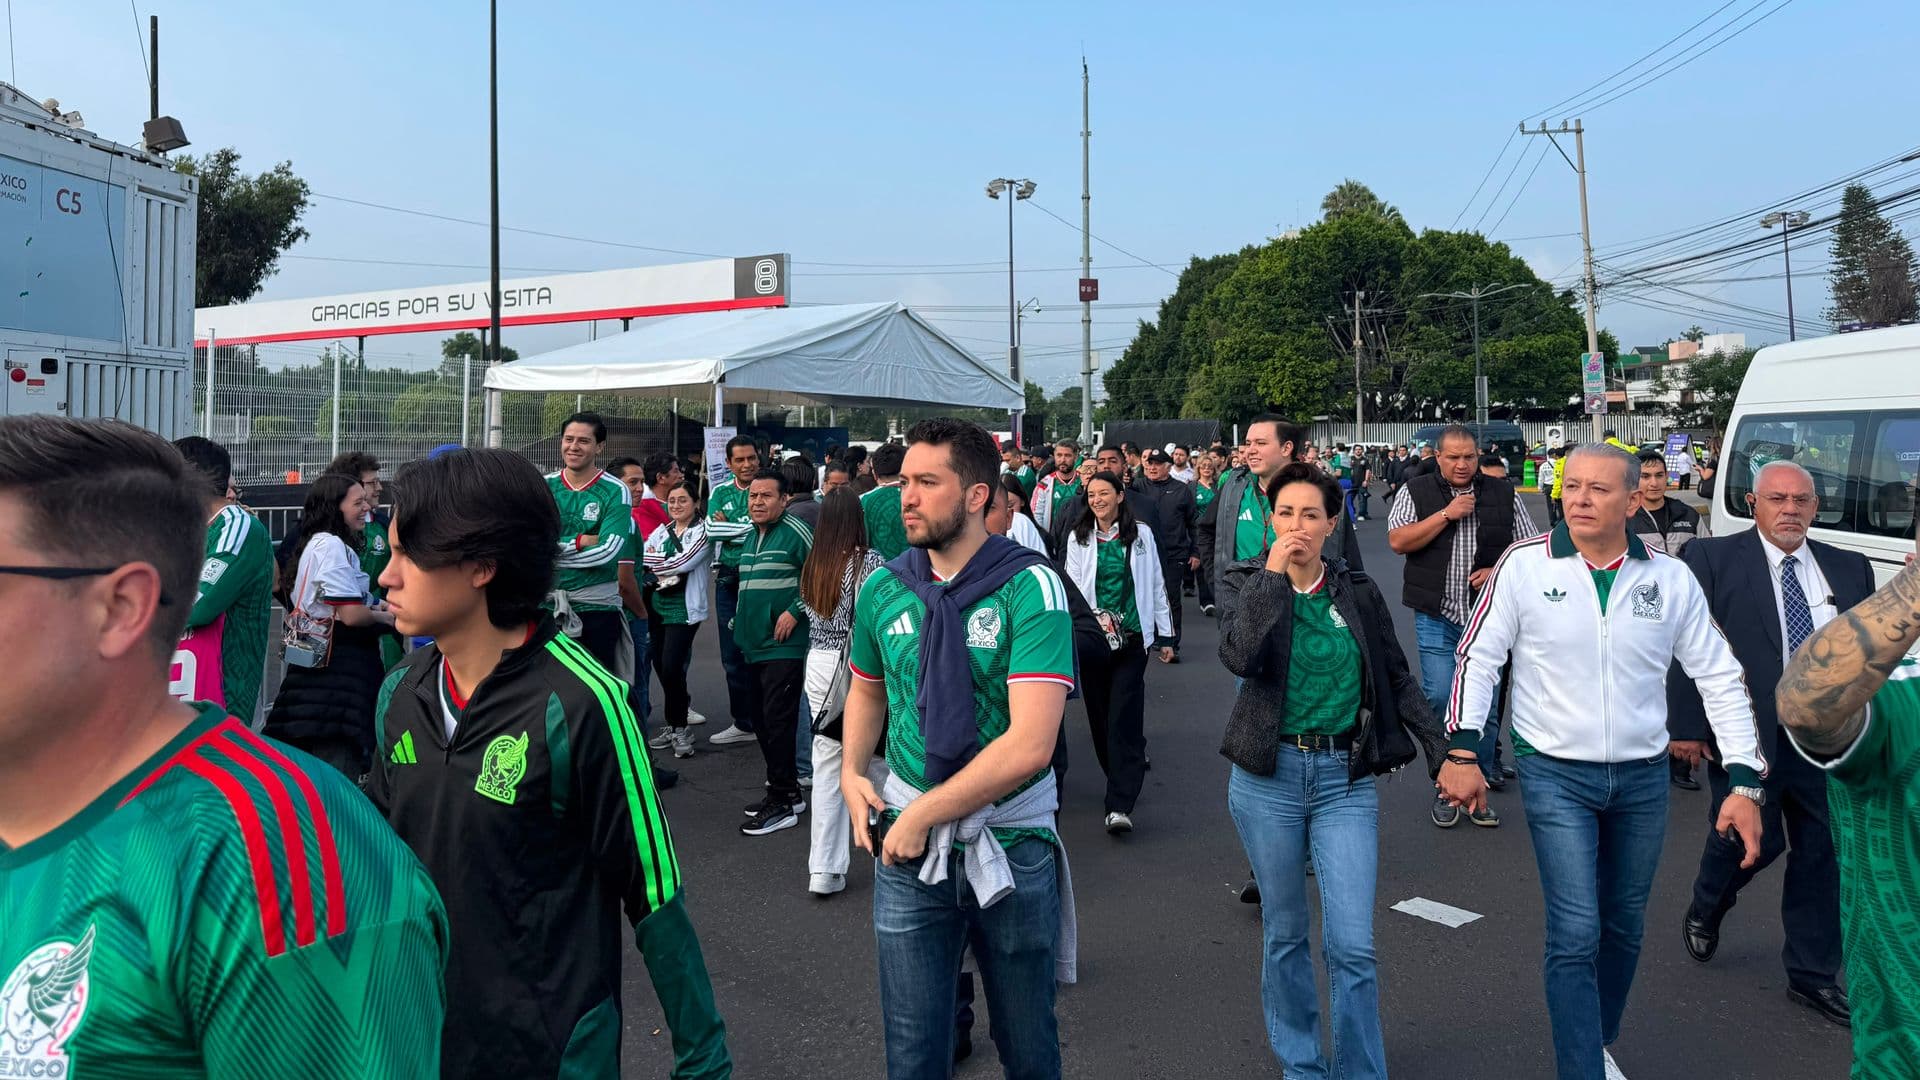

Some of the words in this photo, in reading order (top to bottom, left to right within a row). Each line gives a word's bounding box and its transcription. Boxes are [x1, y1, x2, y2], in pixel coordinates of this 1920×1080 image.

[56, 188, 82, 215] C5
[754, 258, 778, 295] 8
[311, 301, 390, 322] GRACIAS
[397, 297, 439, 316] POR
[447, 293, 475, 311] SU
